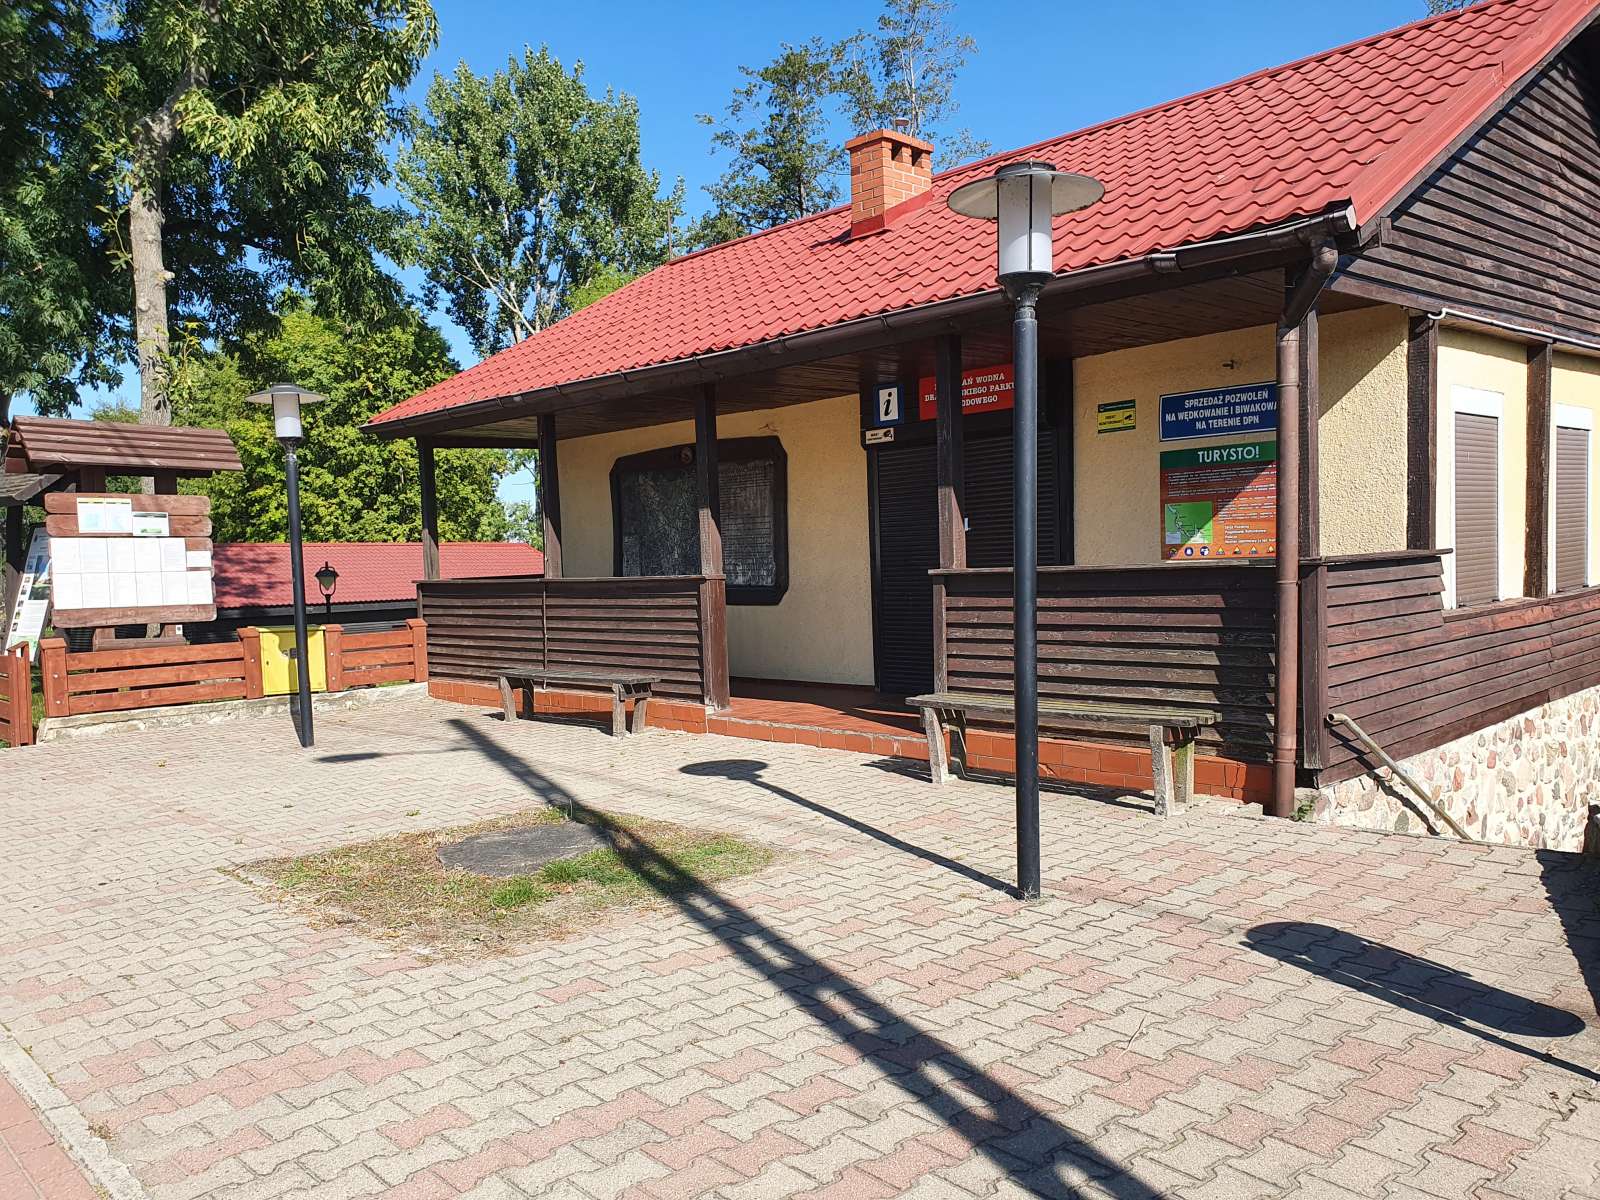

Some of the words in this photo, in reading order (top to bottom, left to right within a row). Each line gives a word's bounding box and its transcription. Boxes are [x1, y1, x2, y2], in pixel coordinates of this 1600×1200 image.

[976, 372, 1005, 384] WODNA
[1184, 393, 1224, 408] SPRZEDAŻ
[1225, 388, 1269, 404] POZWOLEŃ
[1165, 413, 1176, 422] NA
[1177, 407, 1229, 421] WĘDKOWANIE
[1195, 421, 1207, 430] NA
[1208, 417, 1241, 428] TERENIE
[1243, 415, 1260, 425] DPN
[1197, 446, 1260, 463] TURYSTO!
